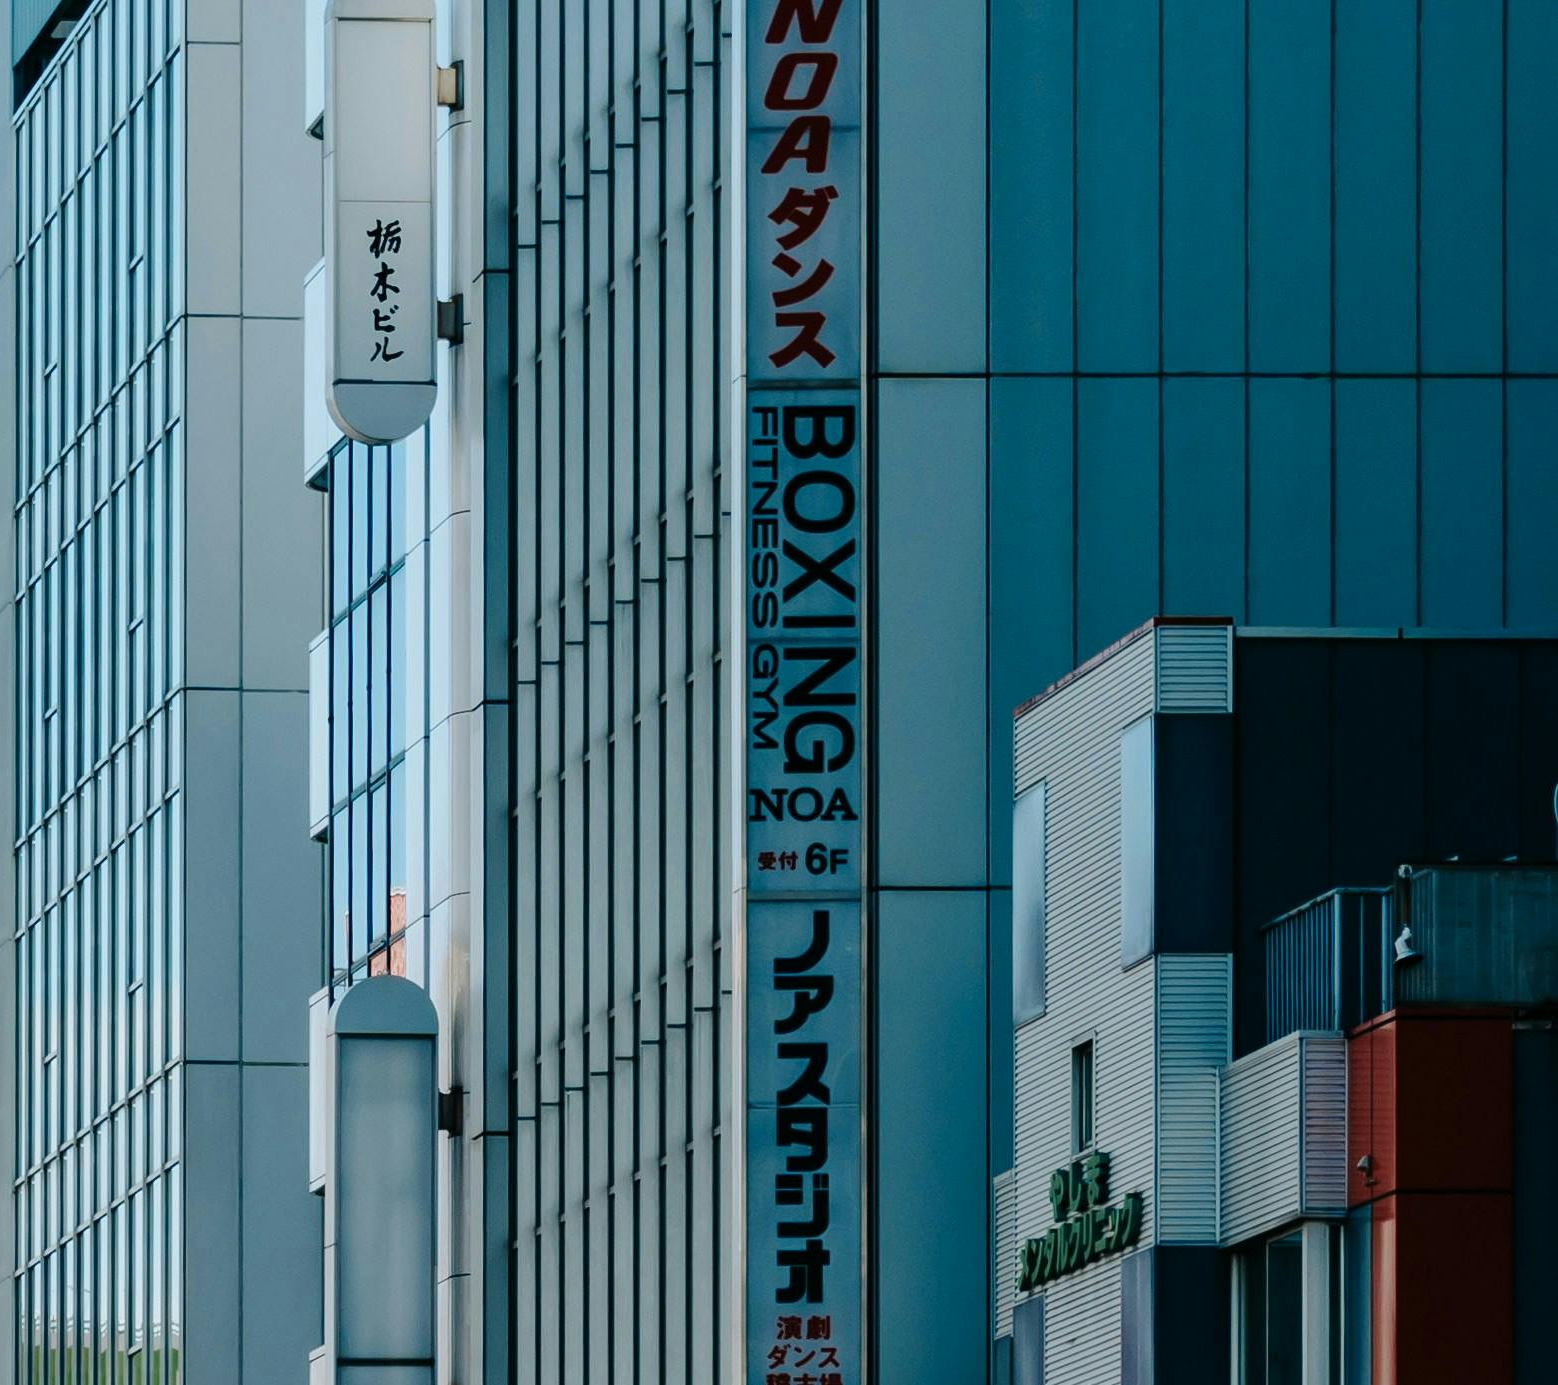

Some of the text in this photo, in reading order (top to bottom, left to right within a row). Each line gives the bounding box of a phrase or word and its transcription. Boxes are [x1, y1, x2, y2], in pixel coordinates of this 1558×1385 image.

[366, 218, 405, 365] 栃木ビル
[751, 406, 779, 751] FITNESS GYM
[782, 405, 857, 774] BOXING
[748, 787, 859, 823] NOA
[757, 841, 849, 876] 受付 6F
[772, 909, 835, 1305] ノアスタジオ
[1046, 1150, 1111, 1222] やしま
[1014, 1191, 1144, 1293] メンタルクリニック
[766, 1345, 841, 1371] ダンス
[776, 1315, 832, 1341] 演劇
